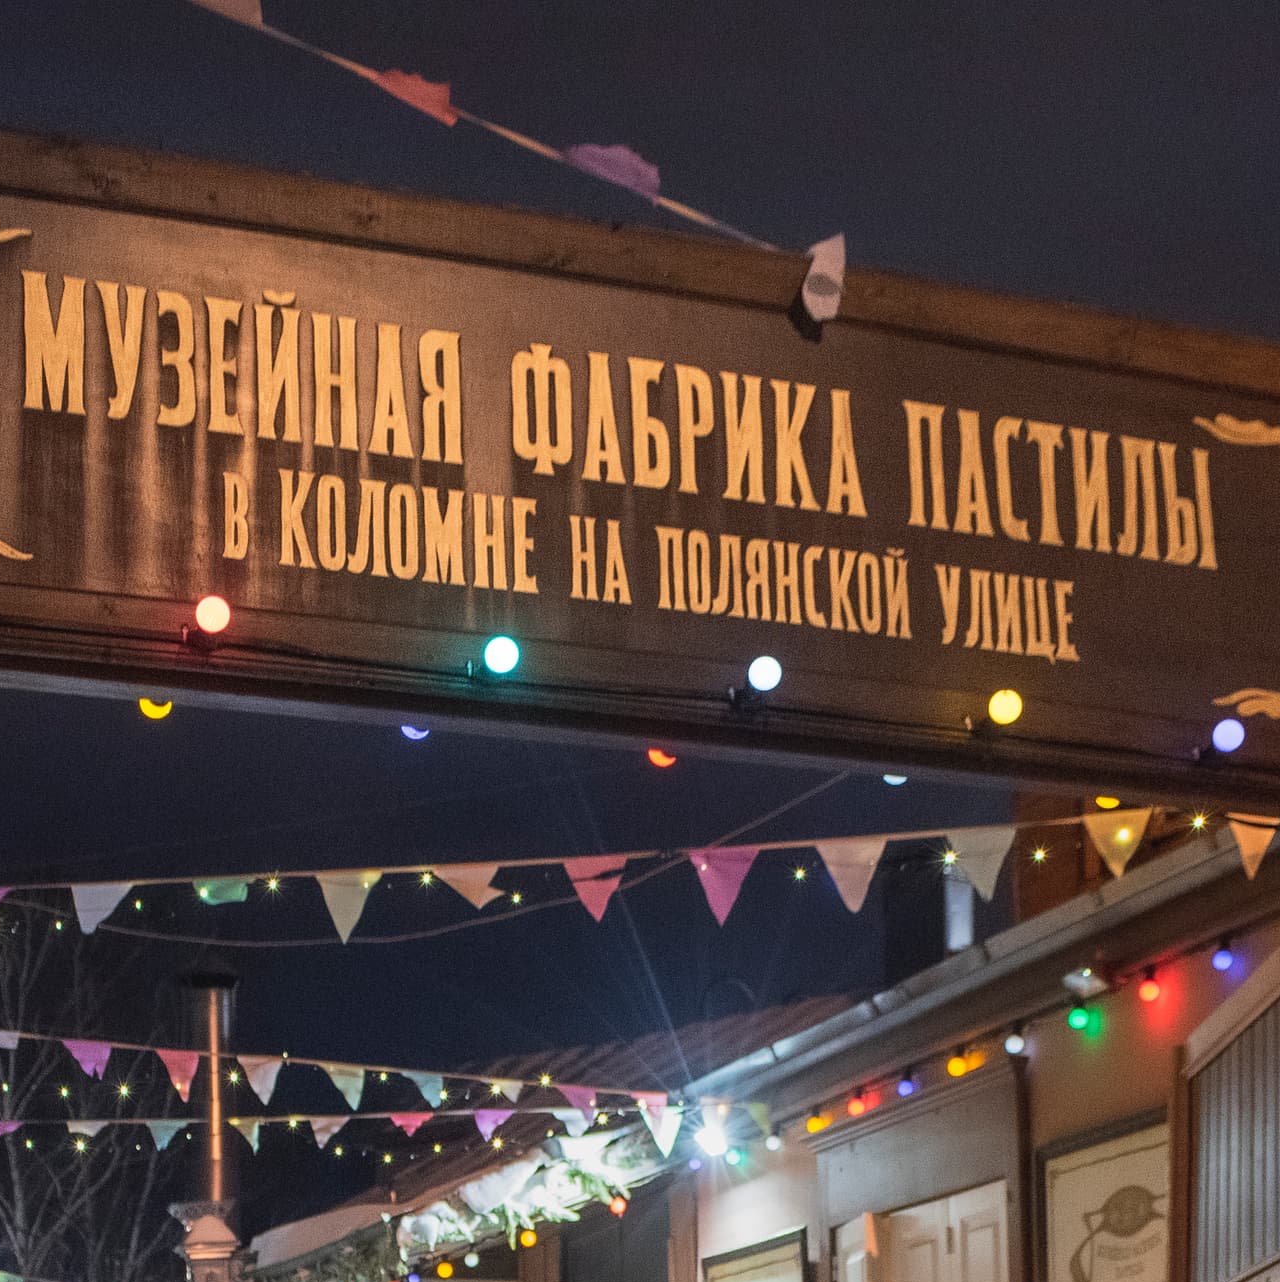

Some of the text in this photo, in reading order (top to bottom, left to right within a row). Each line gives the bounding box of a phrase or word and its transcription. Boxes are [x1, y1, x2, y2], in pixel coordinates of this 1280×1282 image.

[22, 270, 1219, 570] МУЗЕЙНАЯ ФАБРИКА ПАСТИЛЫ
[222, 468, 1080, 665] В КОЛОМНЕ НА ПОЛЯНСКОЙ УЛИЦЕ
